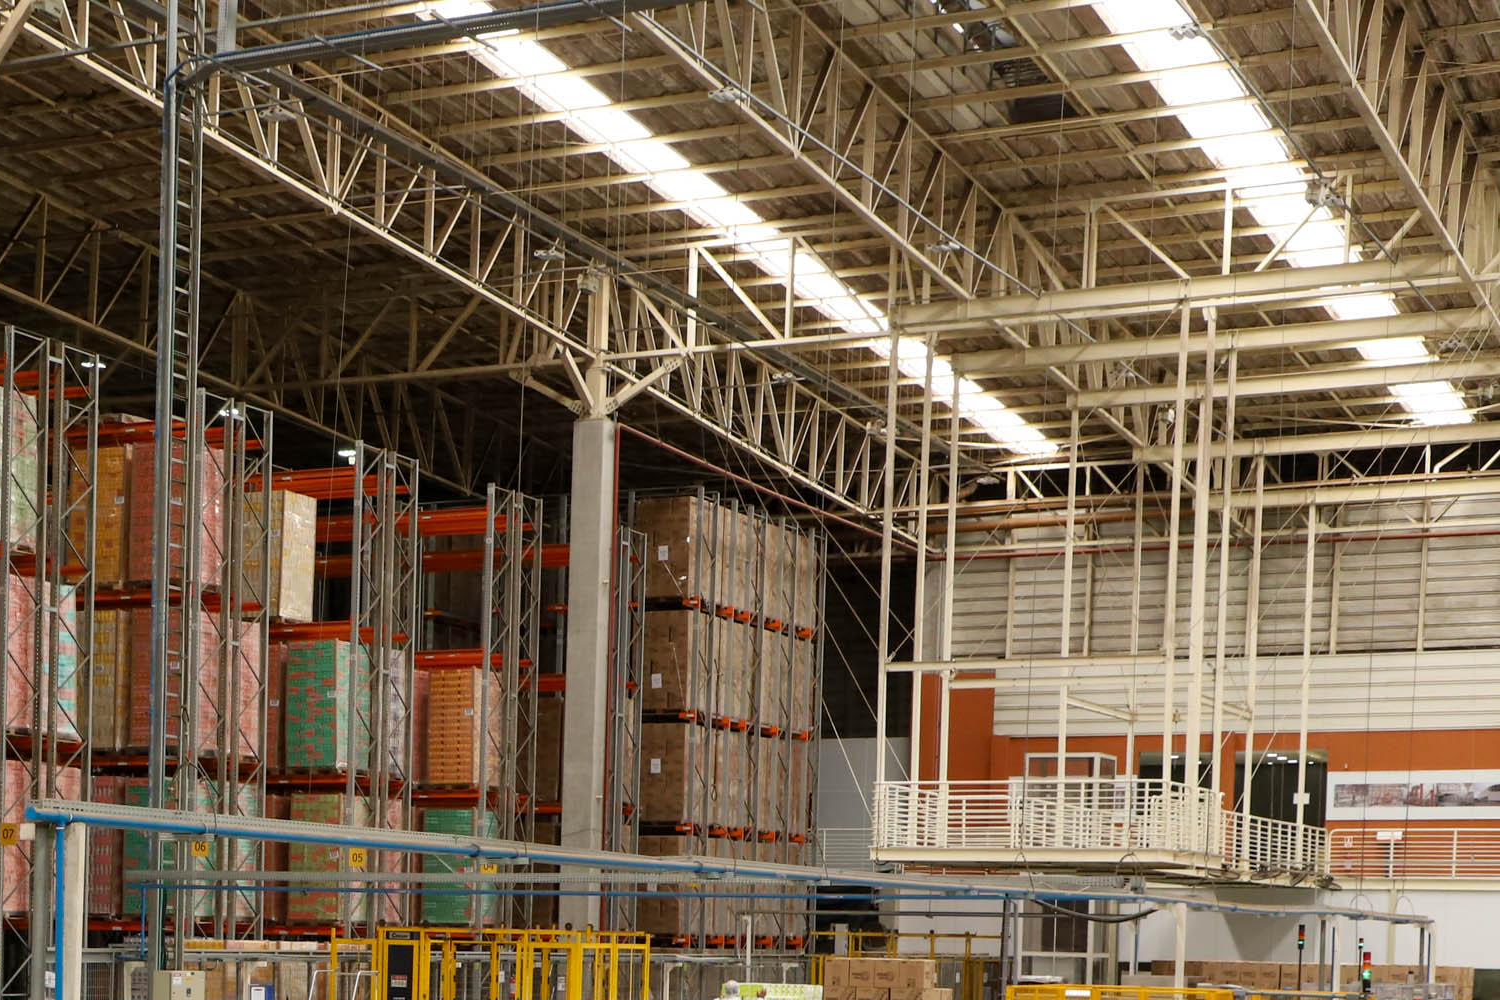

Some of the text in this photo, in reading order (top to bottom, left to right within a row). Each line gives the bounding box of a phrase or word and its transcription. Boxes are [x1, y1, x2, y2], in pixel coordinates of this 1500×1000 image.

[2, 828, 14, 839] 07
[195, 840, 206, 851] 06
[352, 852, 362, 862] 05
